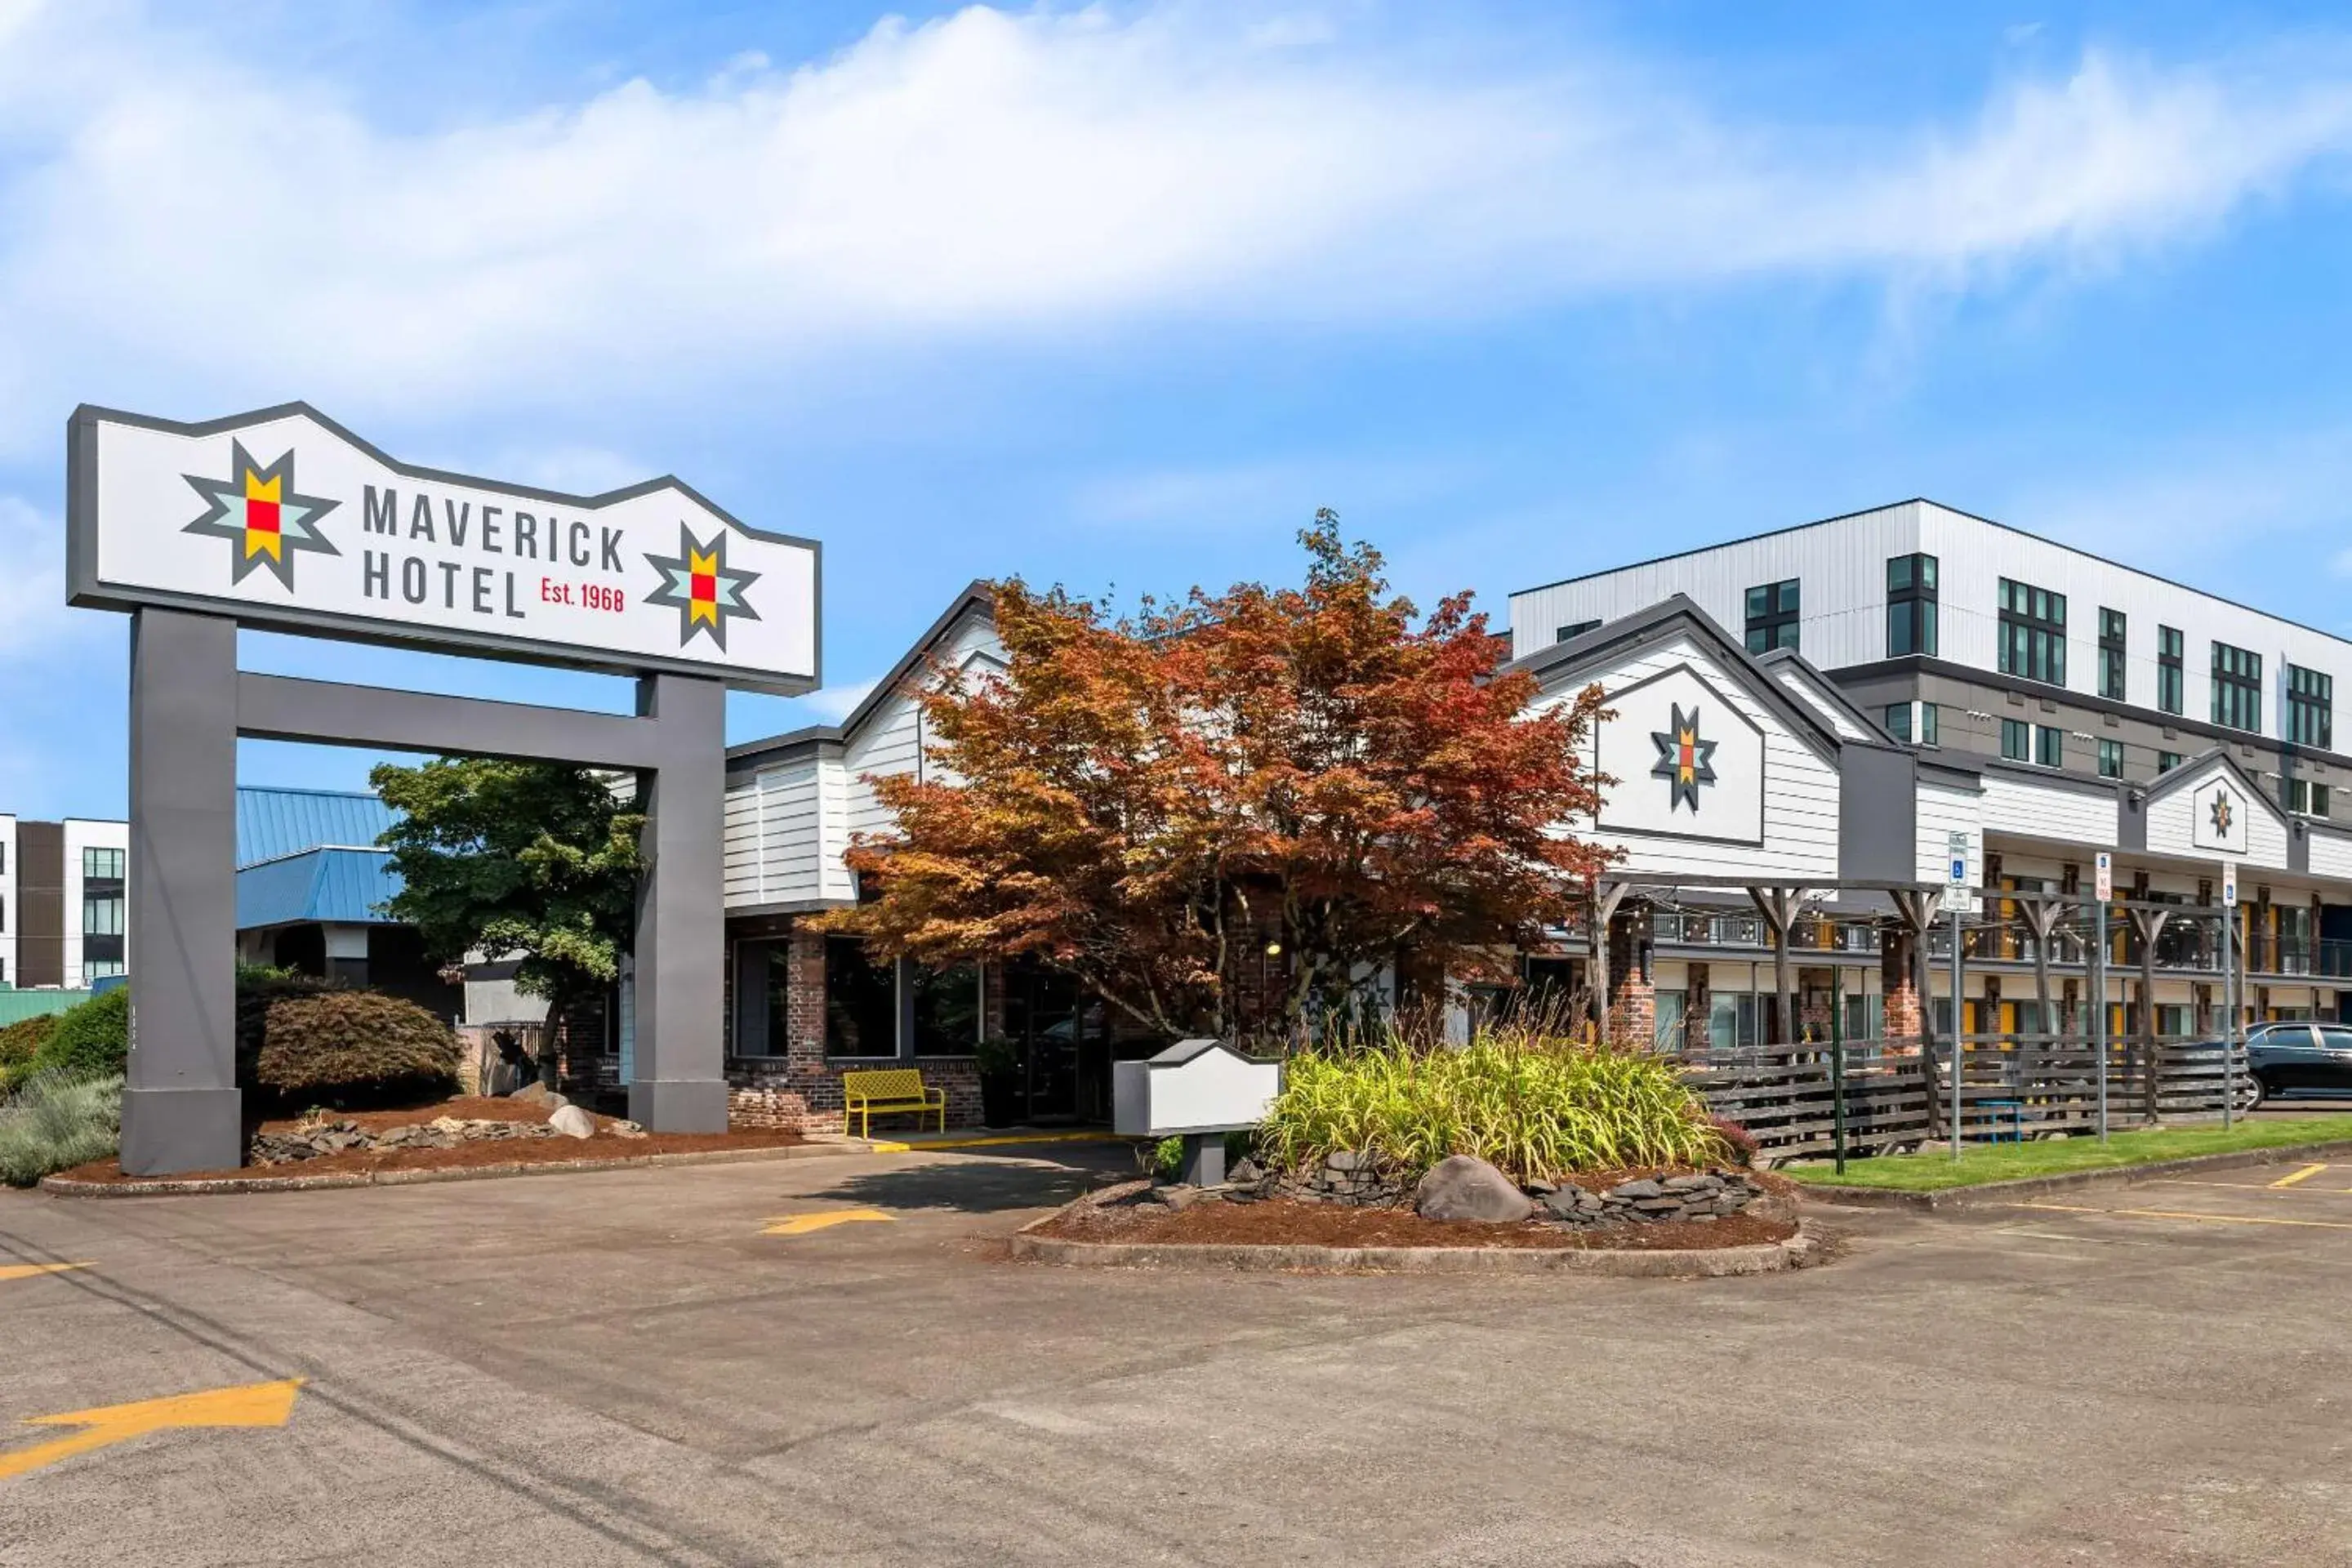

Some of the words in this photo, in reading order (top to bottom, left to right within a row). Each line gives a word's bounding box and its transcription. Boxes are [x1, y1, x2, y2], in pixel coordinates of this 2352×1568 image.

[363, 484, 624, 573] MAVERICK
[363, 550, 526, 619] HOTEL
[541, 577, 575, 605] Est.
[581, 584, 624, 612] 1968
